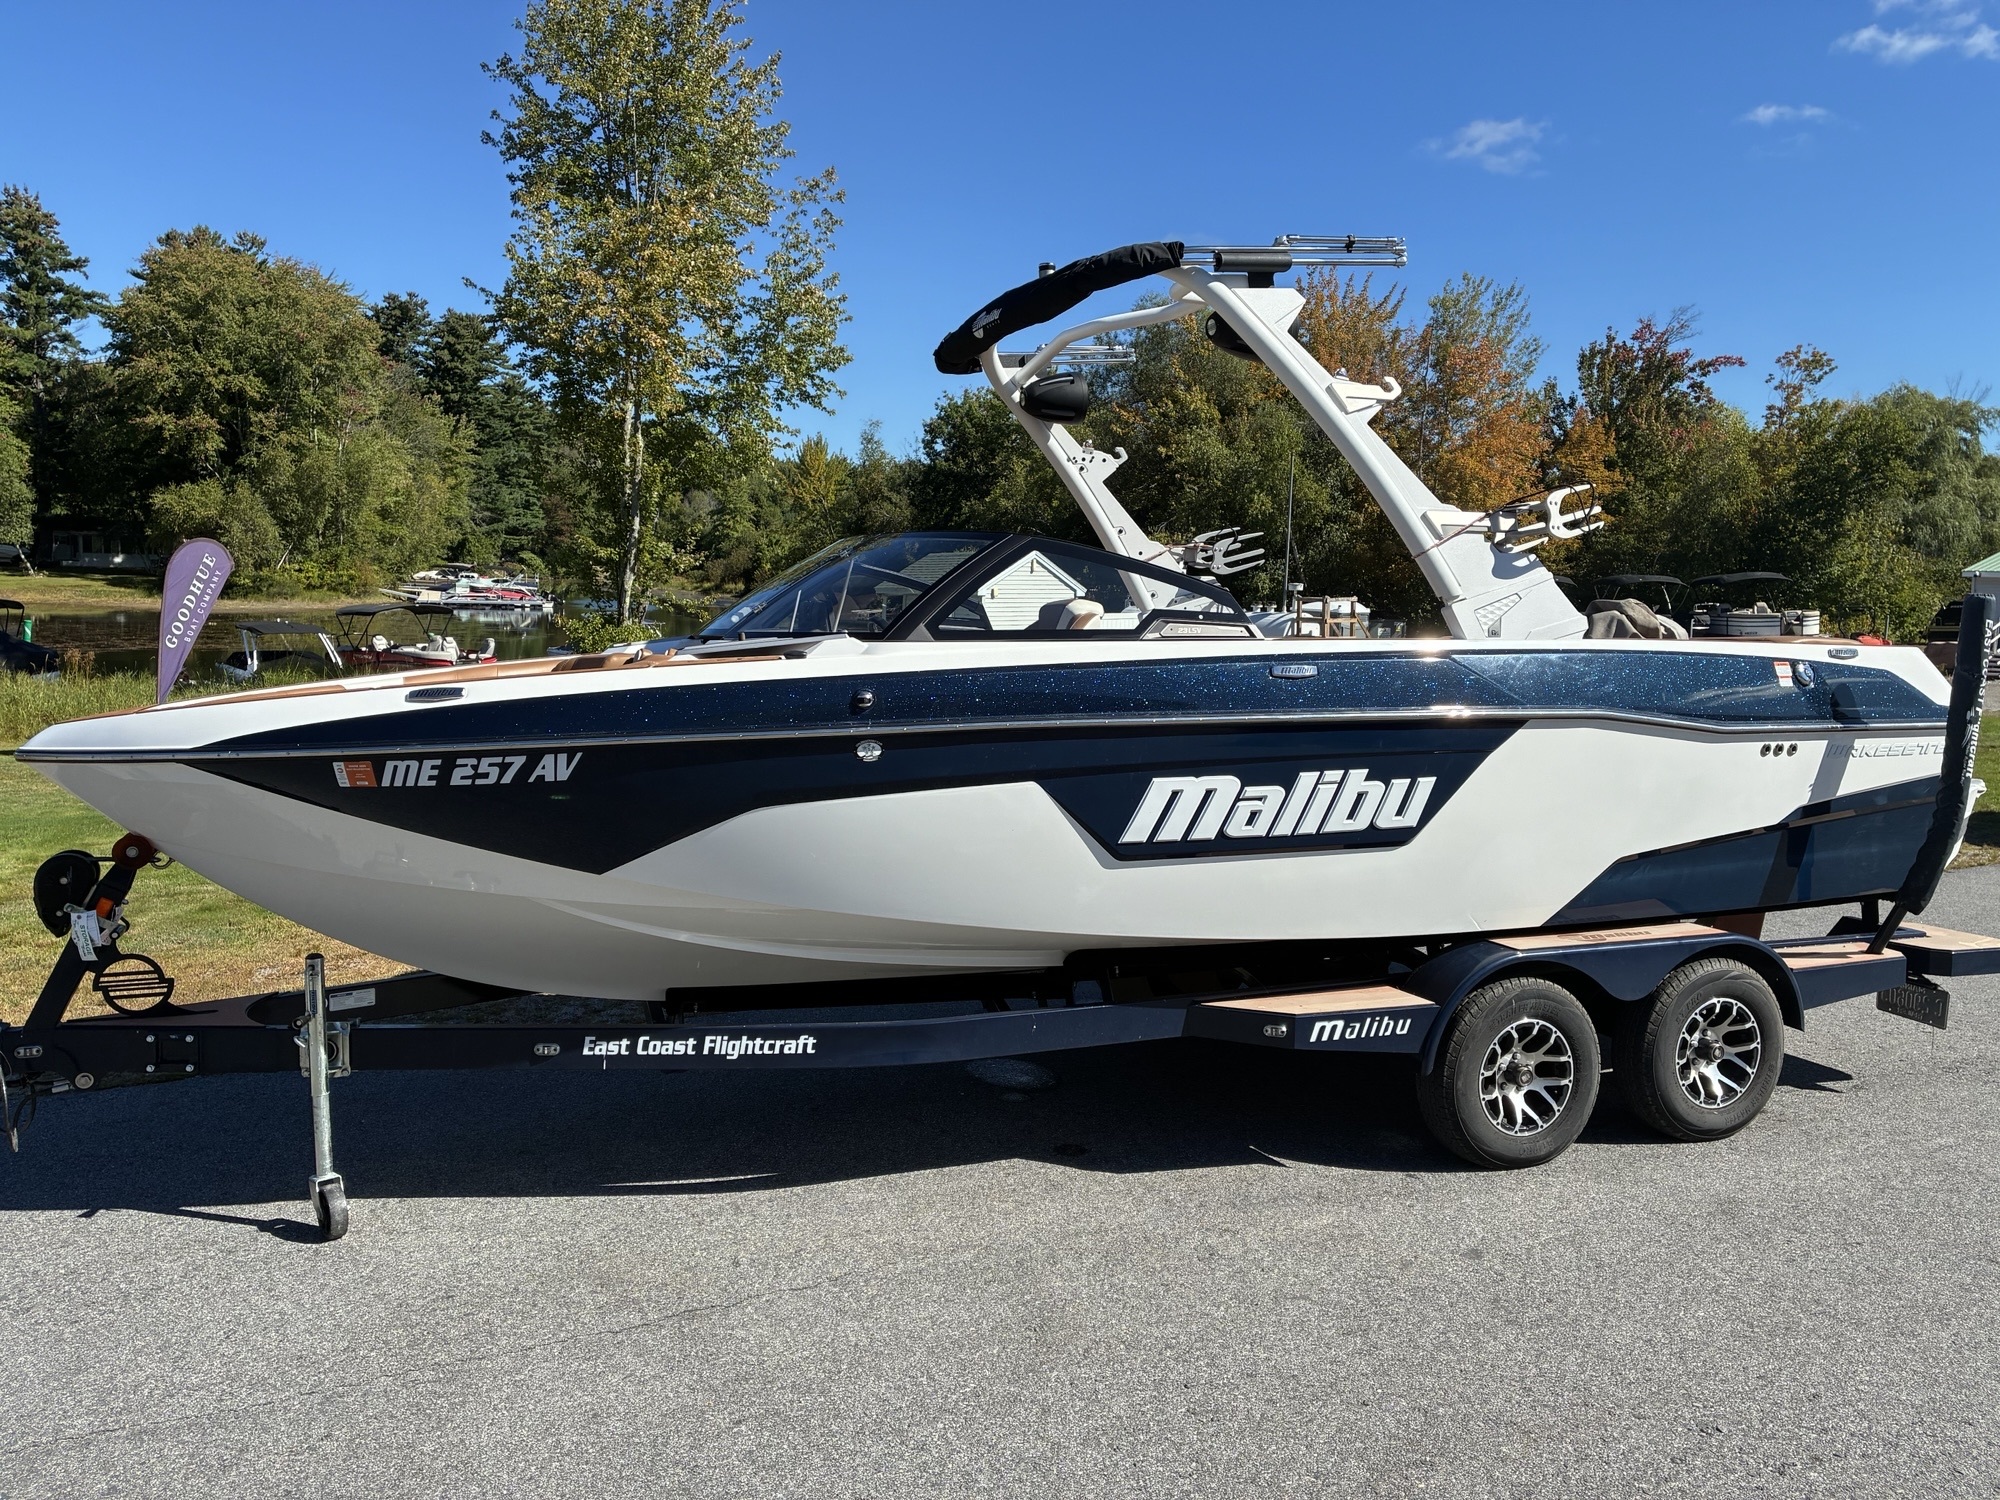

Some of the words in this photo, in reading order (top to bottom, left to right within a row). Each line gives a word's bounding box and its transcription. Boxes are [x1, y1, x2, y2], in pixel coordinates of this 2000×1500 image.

[165, 553, 216, 648] GOODHUE
[184, 618, 200, 642] BOAT
[197, 570, 222, 614] COMPANY
[1280, 666, 1313, 675] Malibu
[1826, 742, 1946, 758] WAKESETTE
[381, 758, 442, 787] ME
[450, 755, 527, 786] 257
[527, 751, 583, 783] AV
[1117, 768, 1438, 845] Malibu
[80, 924, 94, 956] STORAGE
[1309, 1015, 1412, 1043] Malibu
[582, 1036, 630, 1056] East
[636, 1036, 697, 1056] Coast
[702, 1035, 817, 1060] Flightcraft
